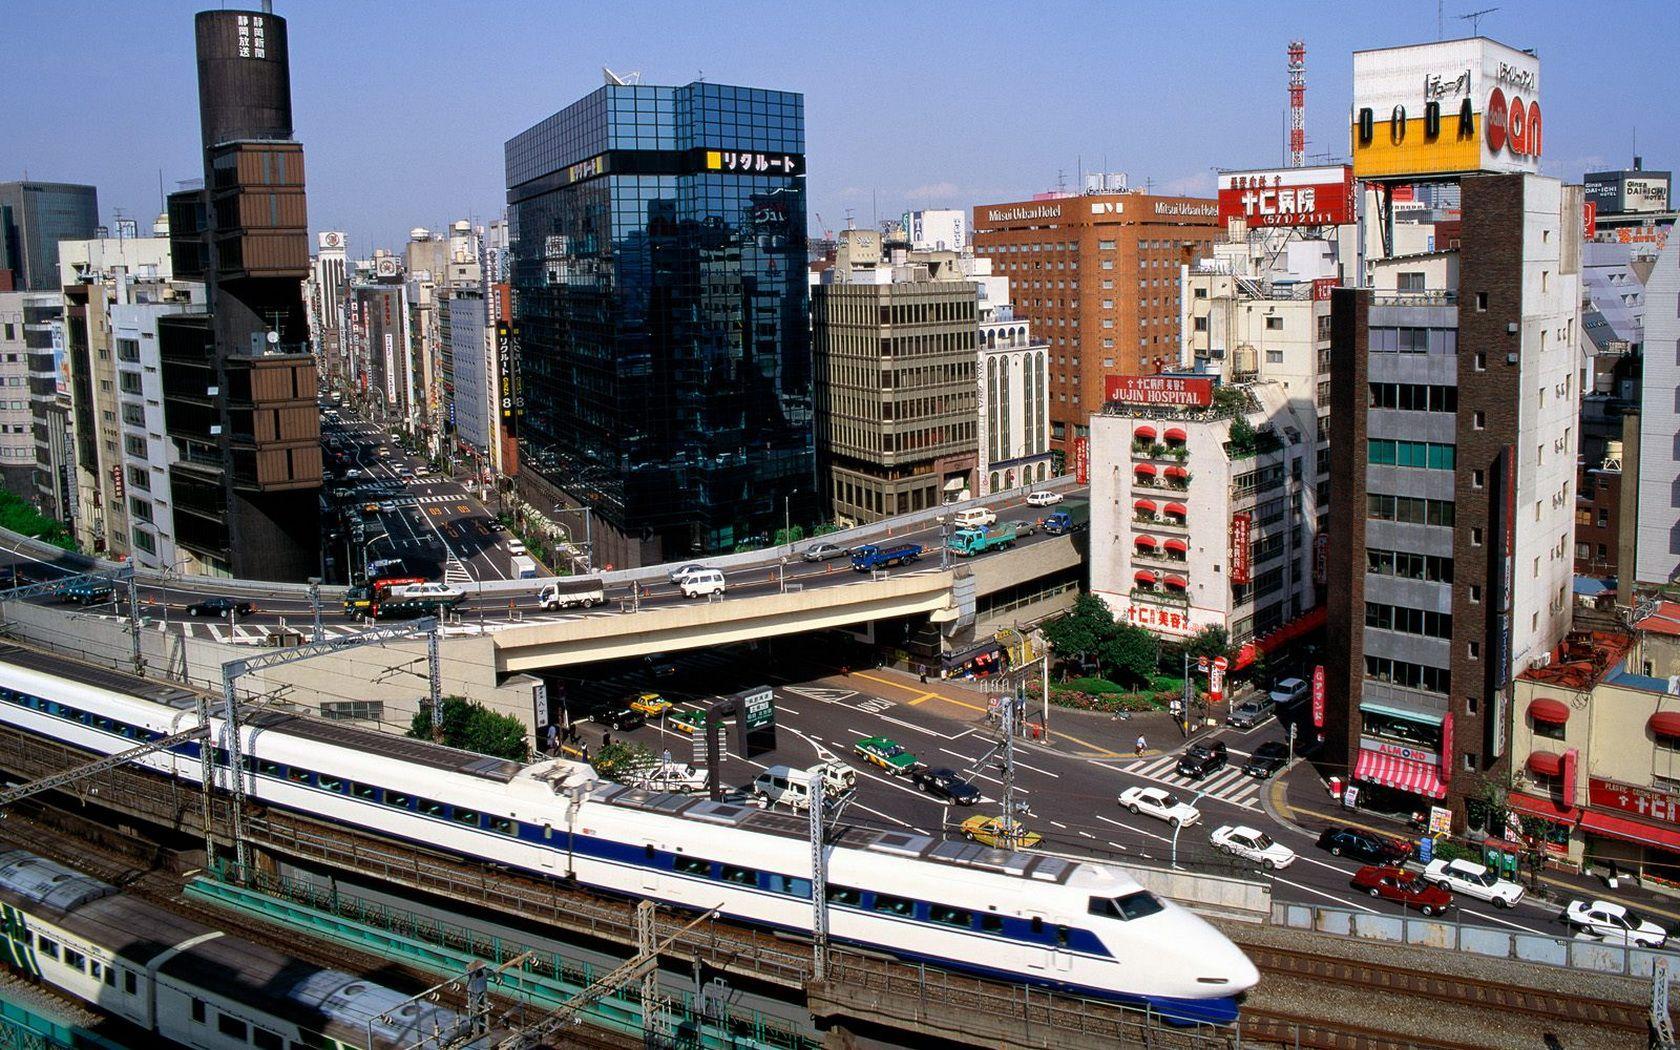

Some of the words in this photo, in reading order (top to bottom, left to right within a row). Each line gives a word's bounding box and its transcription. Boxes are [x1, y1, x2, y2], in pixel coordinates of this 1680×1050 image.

[1360, 98, 1474, 142] DODA
[724, 152, 795, 173] リクルート
[1155, 201, 1178, 215] Mitsui
[1179, 203, 1201, 216] Urban
[1241, 187, 1315, 215] 十仁病院
[989, 209, 1013, 222] Mitsui
[1013, 207, 1038, 220] Urban
[1038, 204, 1060, 218] Hotel
[1300, 213, 1332, 223] 2111
[500, 337, 509, 376] リクルート
[503, 398, 511, 408] 8
[1112, 389, 1144, 402] JUJIN
[1148, 390, 1200, 405] HOSPITAL
[1379, 744, 1427, 760] ALMOND
